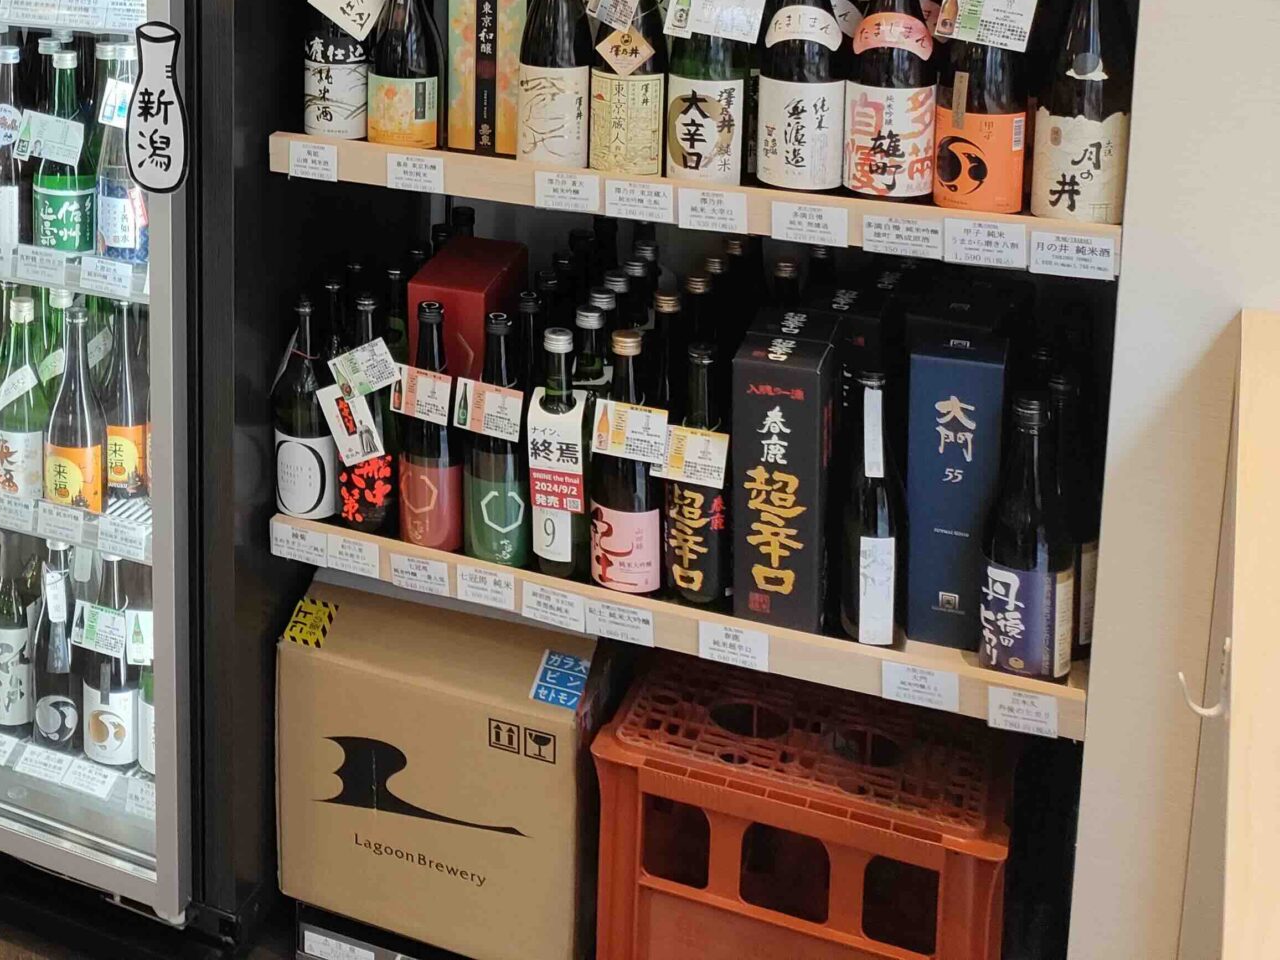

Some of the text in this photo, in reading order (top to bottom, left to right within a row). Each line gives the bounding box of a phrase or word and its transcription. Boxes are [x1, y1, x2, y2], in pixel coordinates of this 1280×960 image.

[858, 21, 929, 50] たまじまん
[136, 87, 175, 174] 新潟
[679, 89, 710, 171] 大辛口
[1048, 141, 1104, 214] 月の井
[1035, 242, 1112, 258] 月の井 純米酒
[755, 405, 792, 465] 春鹿
[934, 395, 977, 463] 大門
[529, 438, 580, 467] 終焉
[534, 480, 578, 497] 2024/9/2
[553, 474, 563, 482] the
[942, 467, 964, 483] 55
[543, 517, 557, 548] 9
[742, 464, 808, 596] 超辛口
[547, 653, 590, 673] ガラス
[545, 670, 582, 687] ビン
[535, 686, 580, 707] セトモノ
